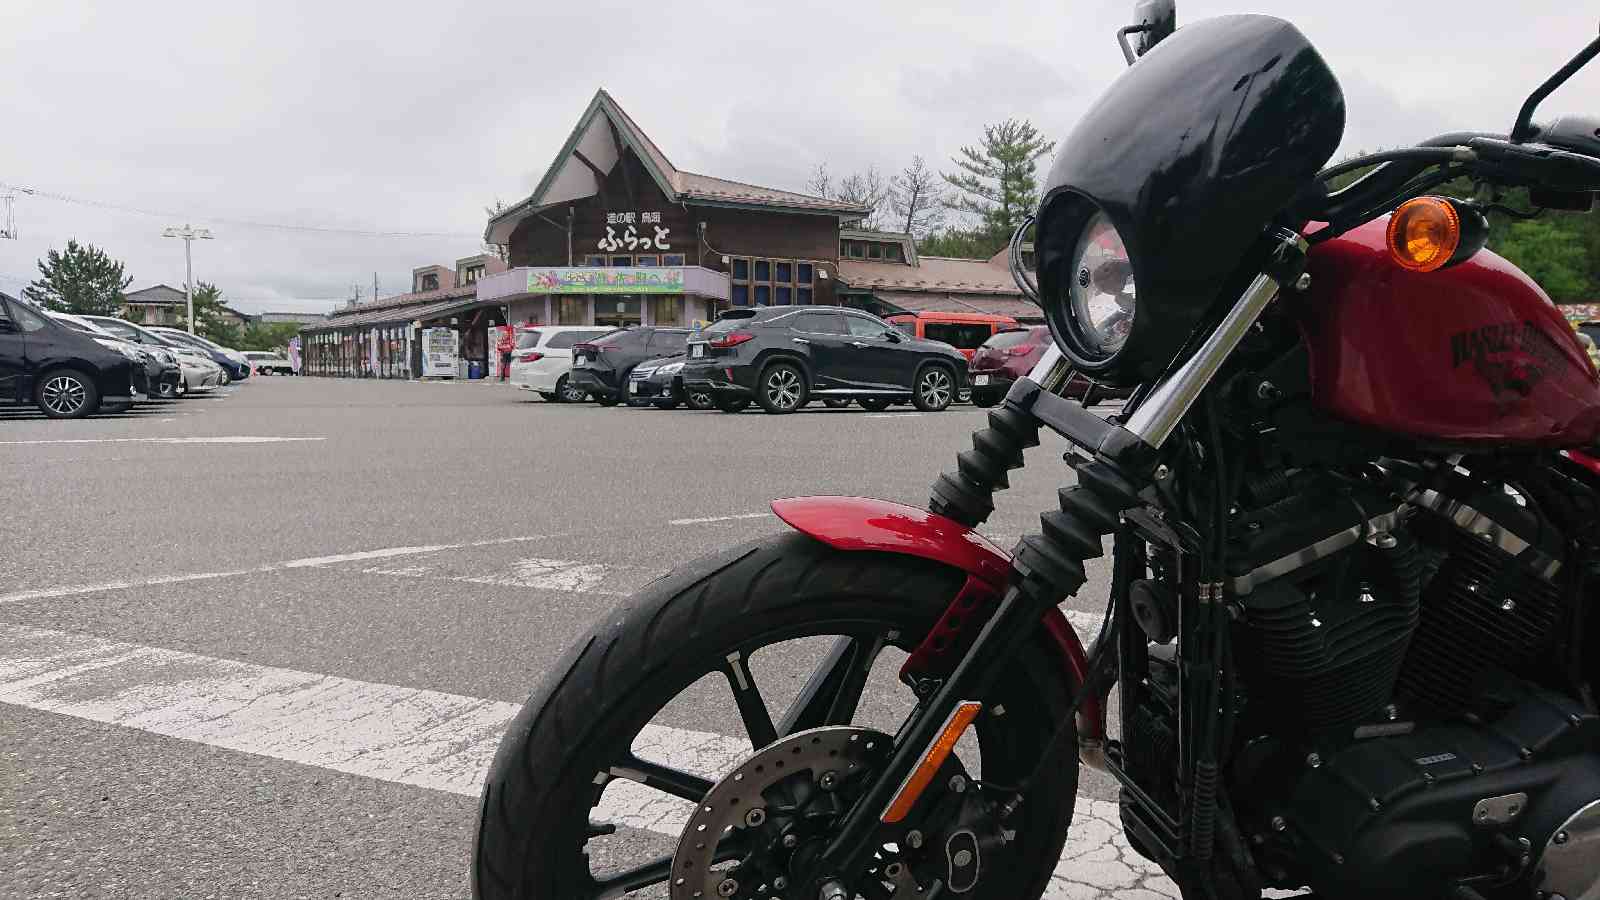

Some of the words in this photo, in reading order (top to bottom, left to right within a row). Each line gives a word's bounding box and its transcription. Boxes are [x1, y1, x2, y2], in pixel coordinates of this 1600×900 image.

[606, 212, 636, 224] 道の駅
[597, 225, 670, 251] ふらっと
